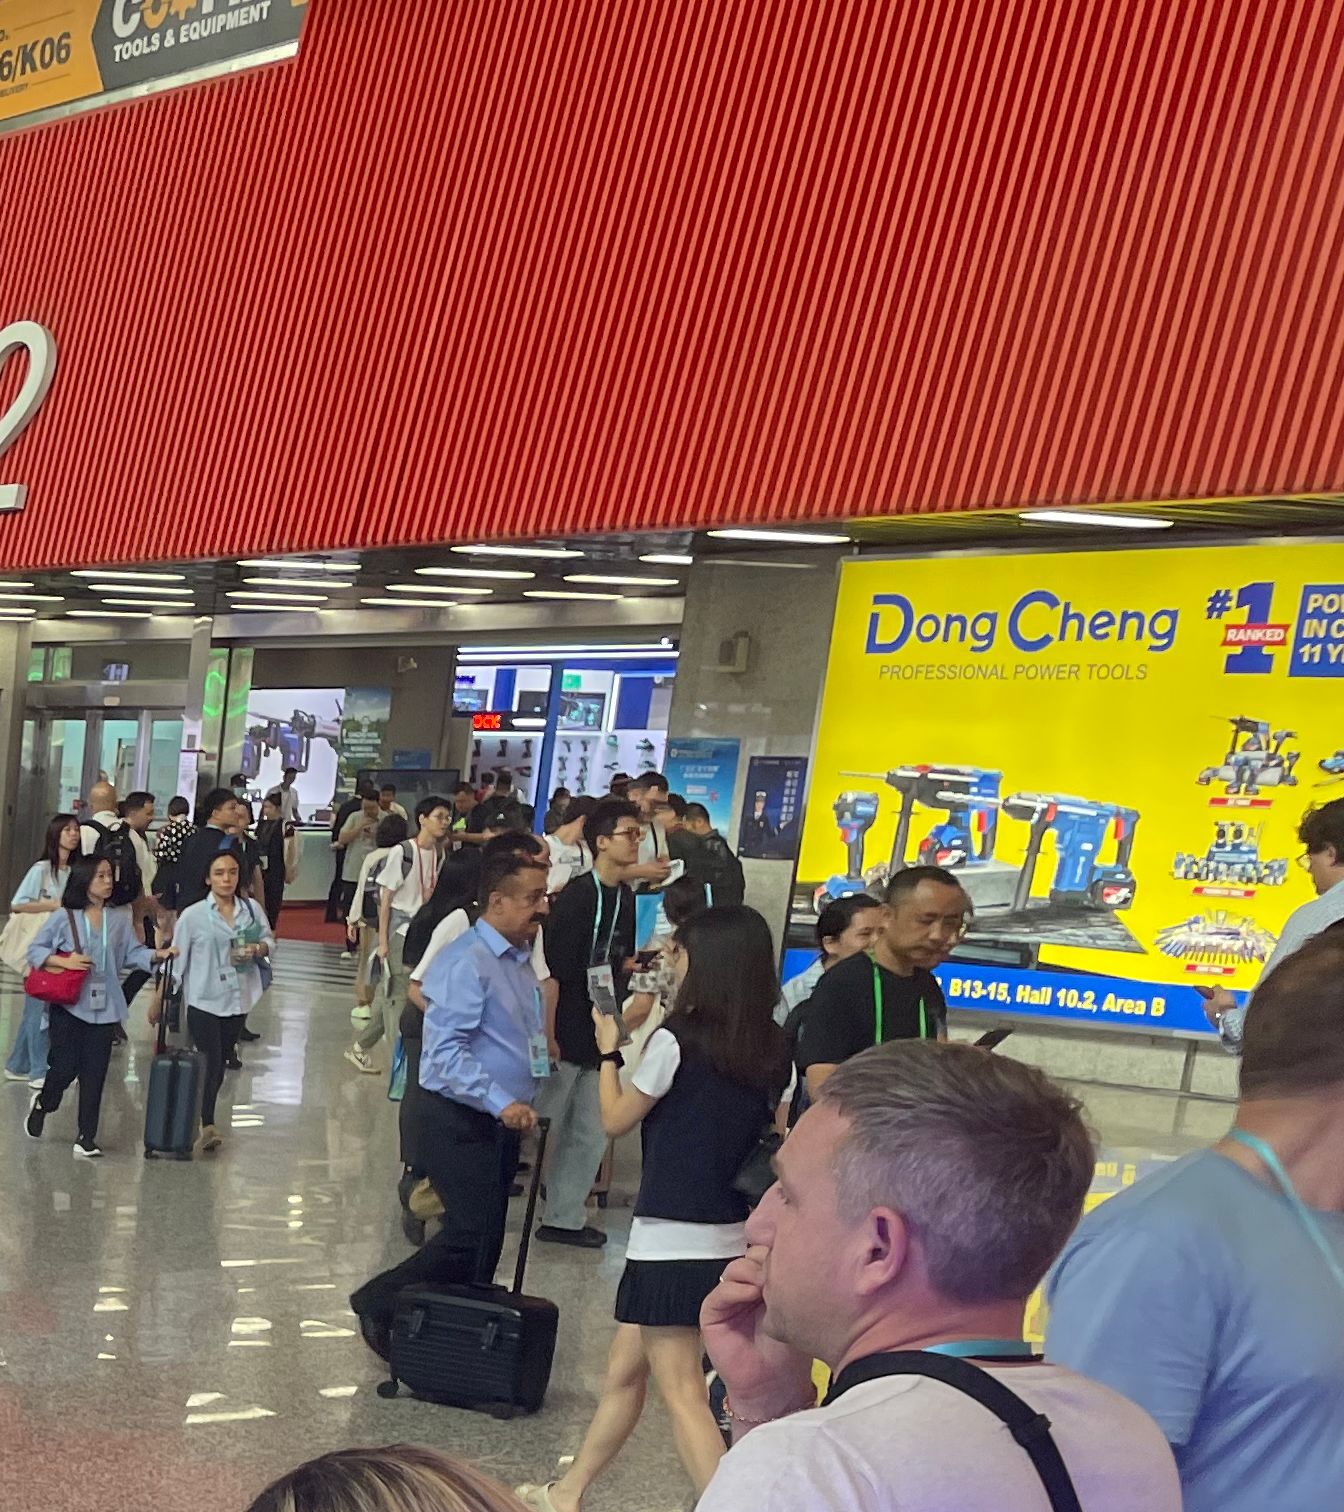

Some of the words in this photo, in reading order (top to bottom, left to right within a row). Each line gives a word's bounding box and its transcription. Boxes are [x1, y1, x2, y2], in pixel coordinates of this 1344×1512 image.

[113, 32, 160, 63] TOOLS
[164, 28, 175, 48] &
[180, 0, 272, 44] EQUIPMENT
[864, 592, 999, 654] Dong
[1007, 590, 1180, 653] Cheng
[1301, 617, 1327, 638] IN
[1225, 626, 1287, 645] RANKED
[1298, 644, 1321, 664] 11
[878, 663, 1009, 681] PROFESSIONAL
[1013, 663, 1080, 681] POWER
[1085, 663, 1148, 681] TOOLS
[948, 978, 1012, 1004] B13-15,
[1015, 984, 1052, 1006] Hall
[1056, 988, 1098, 1014] 10.2,
[1101, 993, 1147, 1016] Area
[1150, 997, 1166, 1017] B
